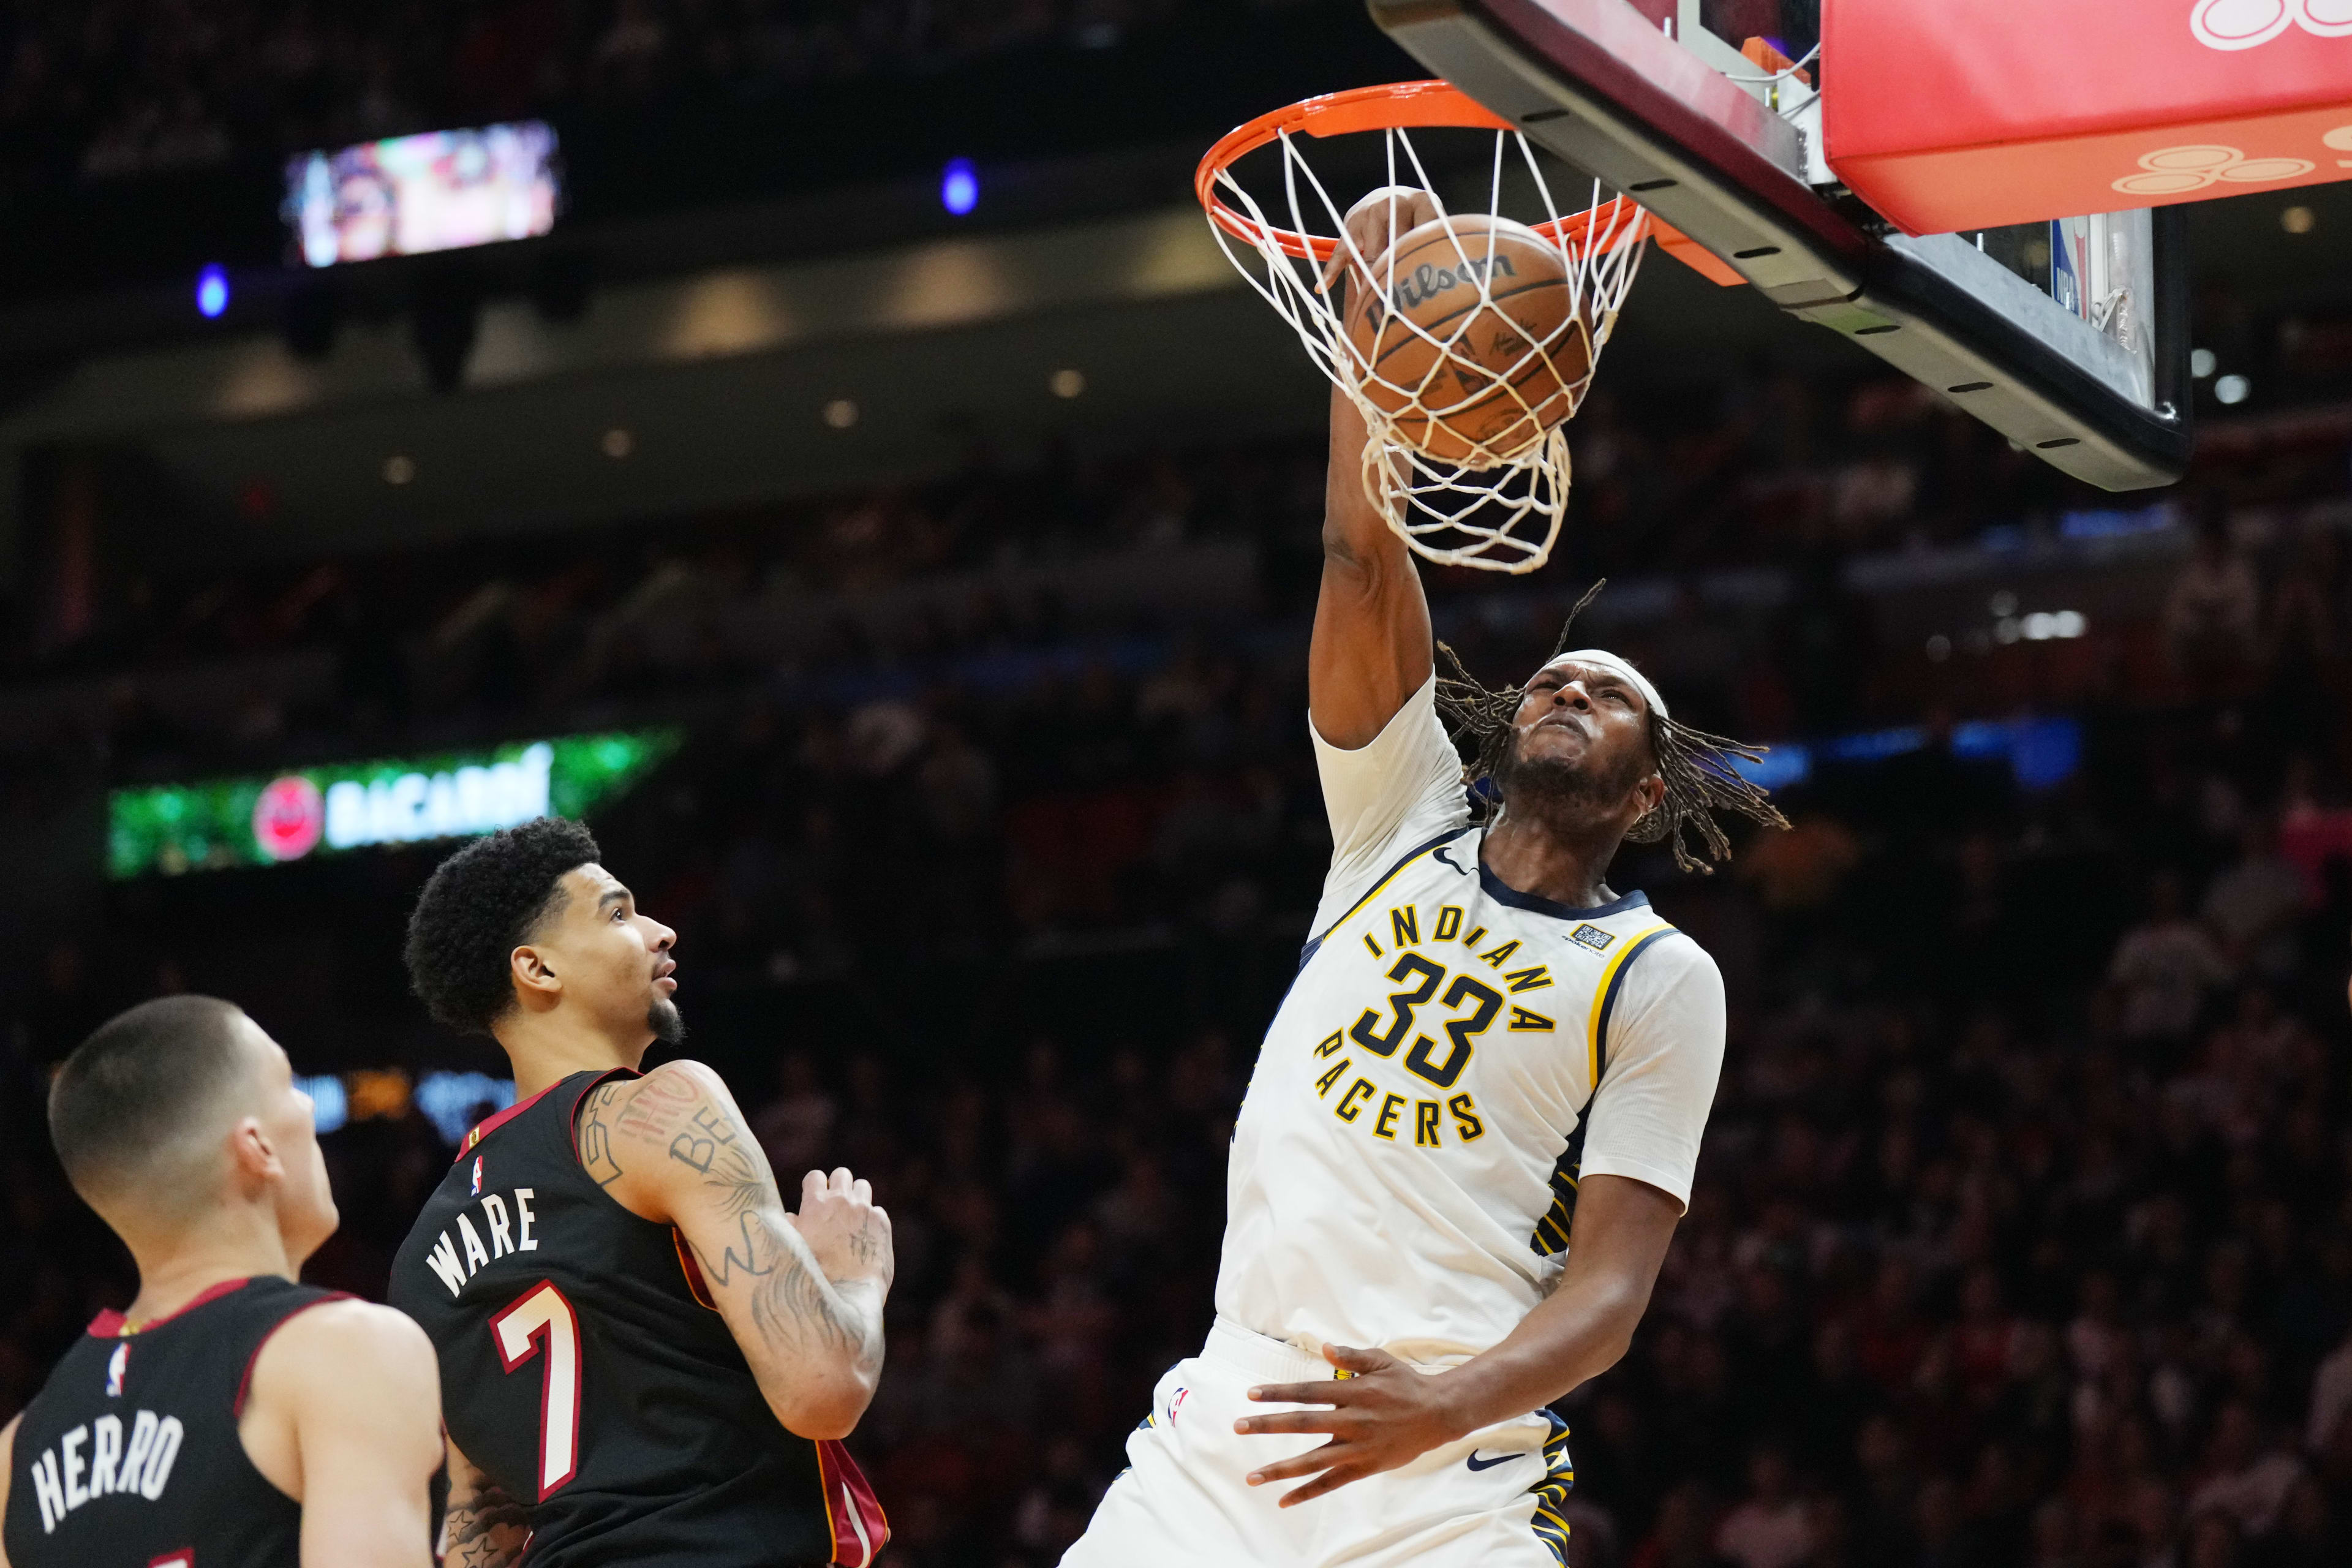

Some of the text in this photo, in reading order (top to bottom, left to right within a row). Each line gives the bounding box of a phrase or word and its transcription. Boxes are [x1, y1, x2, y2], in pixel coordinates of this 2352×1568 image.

[1348, 951, 1506, 1091] 33
[1363, 904, 1556, 1033] INDIANA
[1313, 1027, 1485, 1148] PACERS
[426, 1187, 546, 1298] WARE
[488, 1278, 582, 1504] 7
[31, 1410, 184, 1534] HERRO
